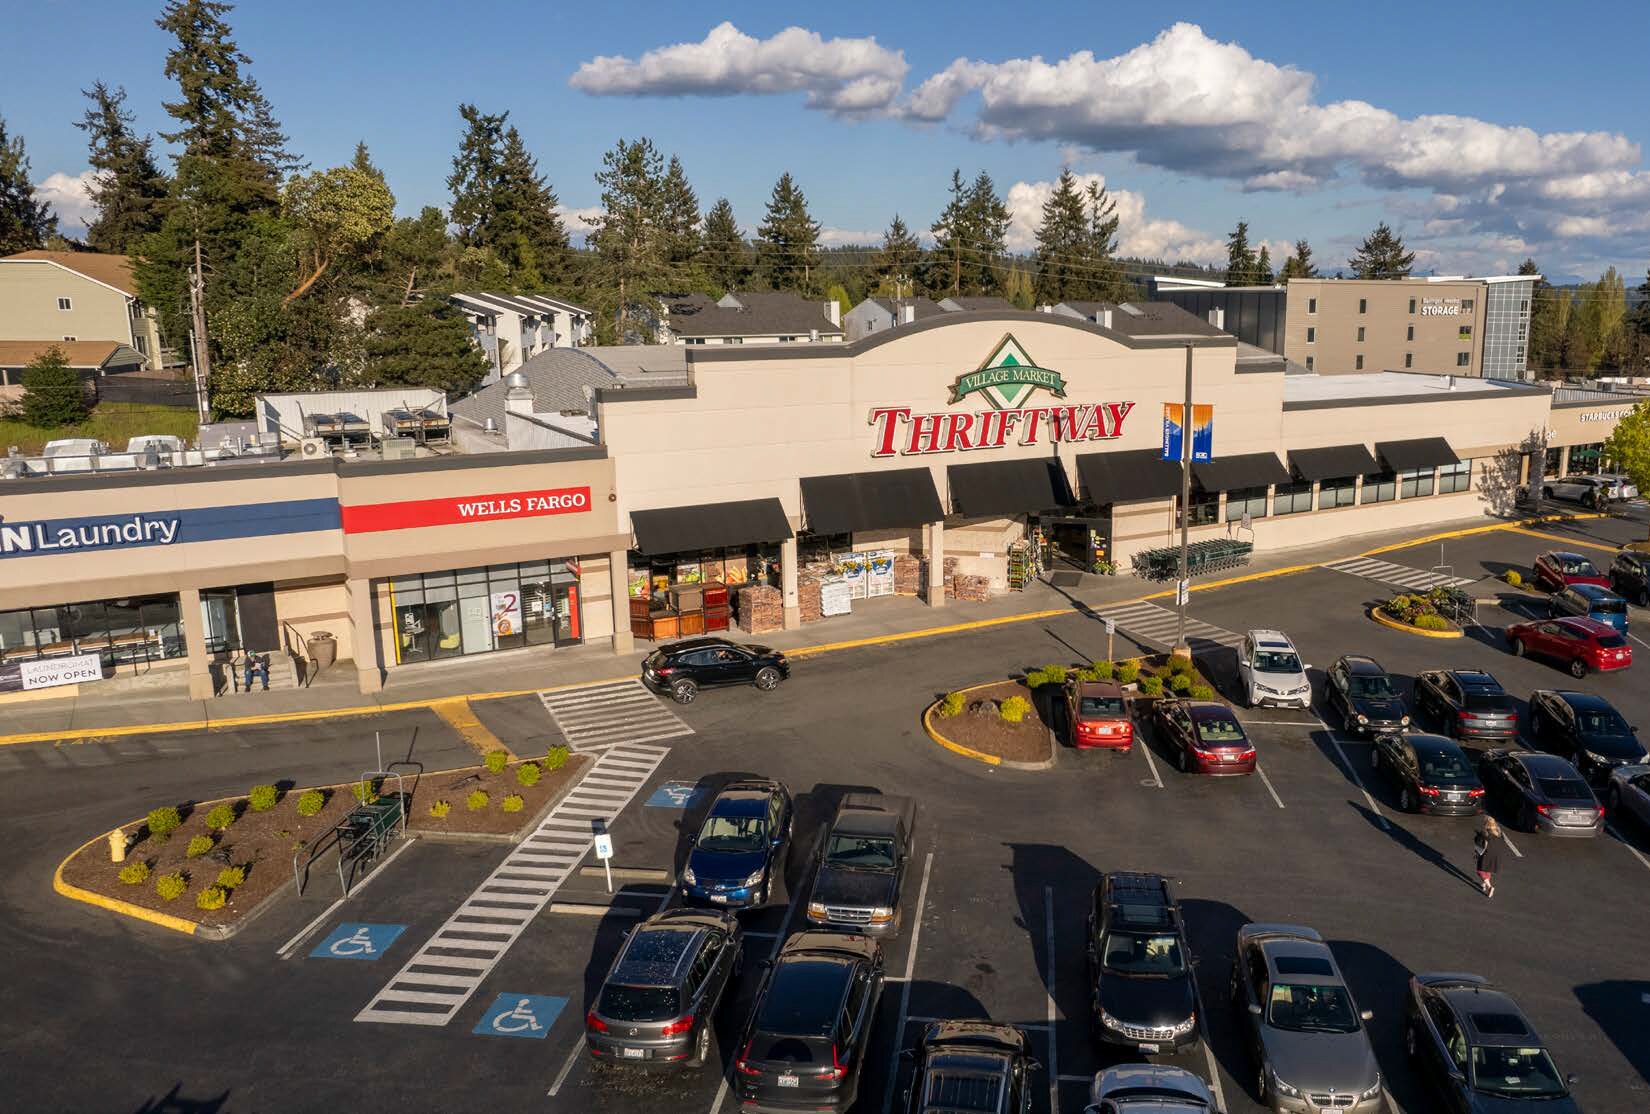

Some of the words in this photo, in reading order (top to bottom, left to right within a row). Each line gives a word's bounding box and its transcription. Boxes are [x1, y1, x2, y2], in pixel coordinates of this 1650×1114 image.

[1422, 305, 1459, 316] STORAGE
[966, 370, 1010, 388] VILLAGE
[1013, 369, 1057, 385] MARKET
[871, 401, 1136, 457] THRIFTWAY
[457, 498, 522, 517] WELLS
[526, 493, 586, 511] FARGO
[36, 517, 180, 549] Laundry
[503, 593, 518, 613] 2
[29, 673, 59, 685] NOW
[63, 668, 96, 680] OPEN
